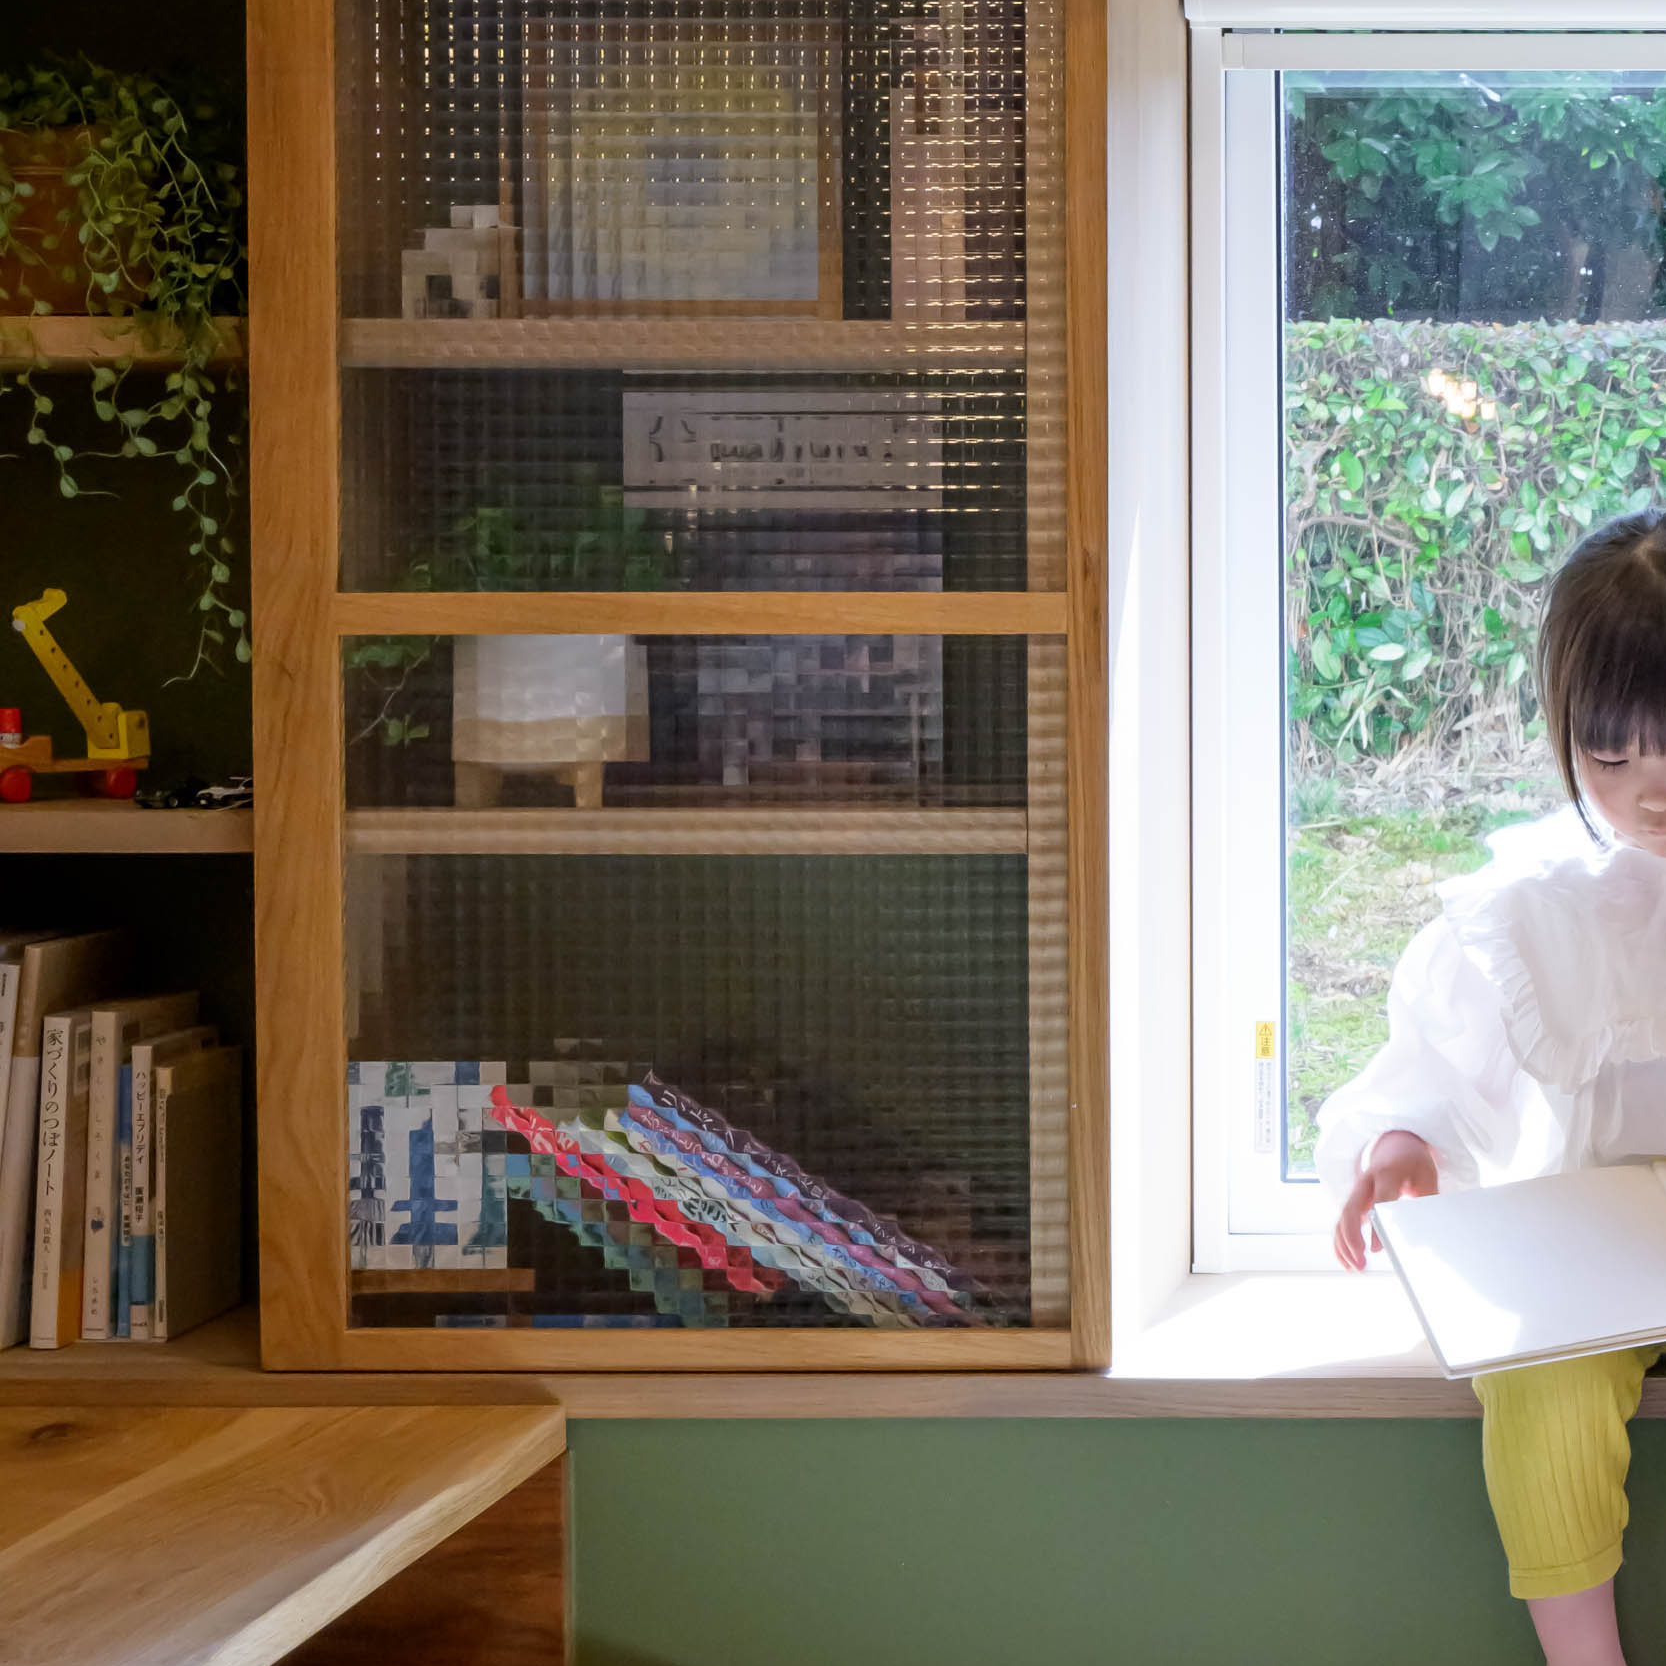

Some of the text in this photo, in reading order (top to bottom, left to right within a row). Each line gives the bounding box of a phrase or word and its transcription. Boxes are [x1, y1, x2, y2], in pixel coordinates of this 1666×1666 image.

[43, 1029, 64, 1196] 家づくりのつぼノート
